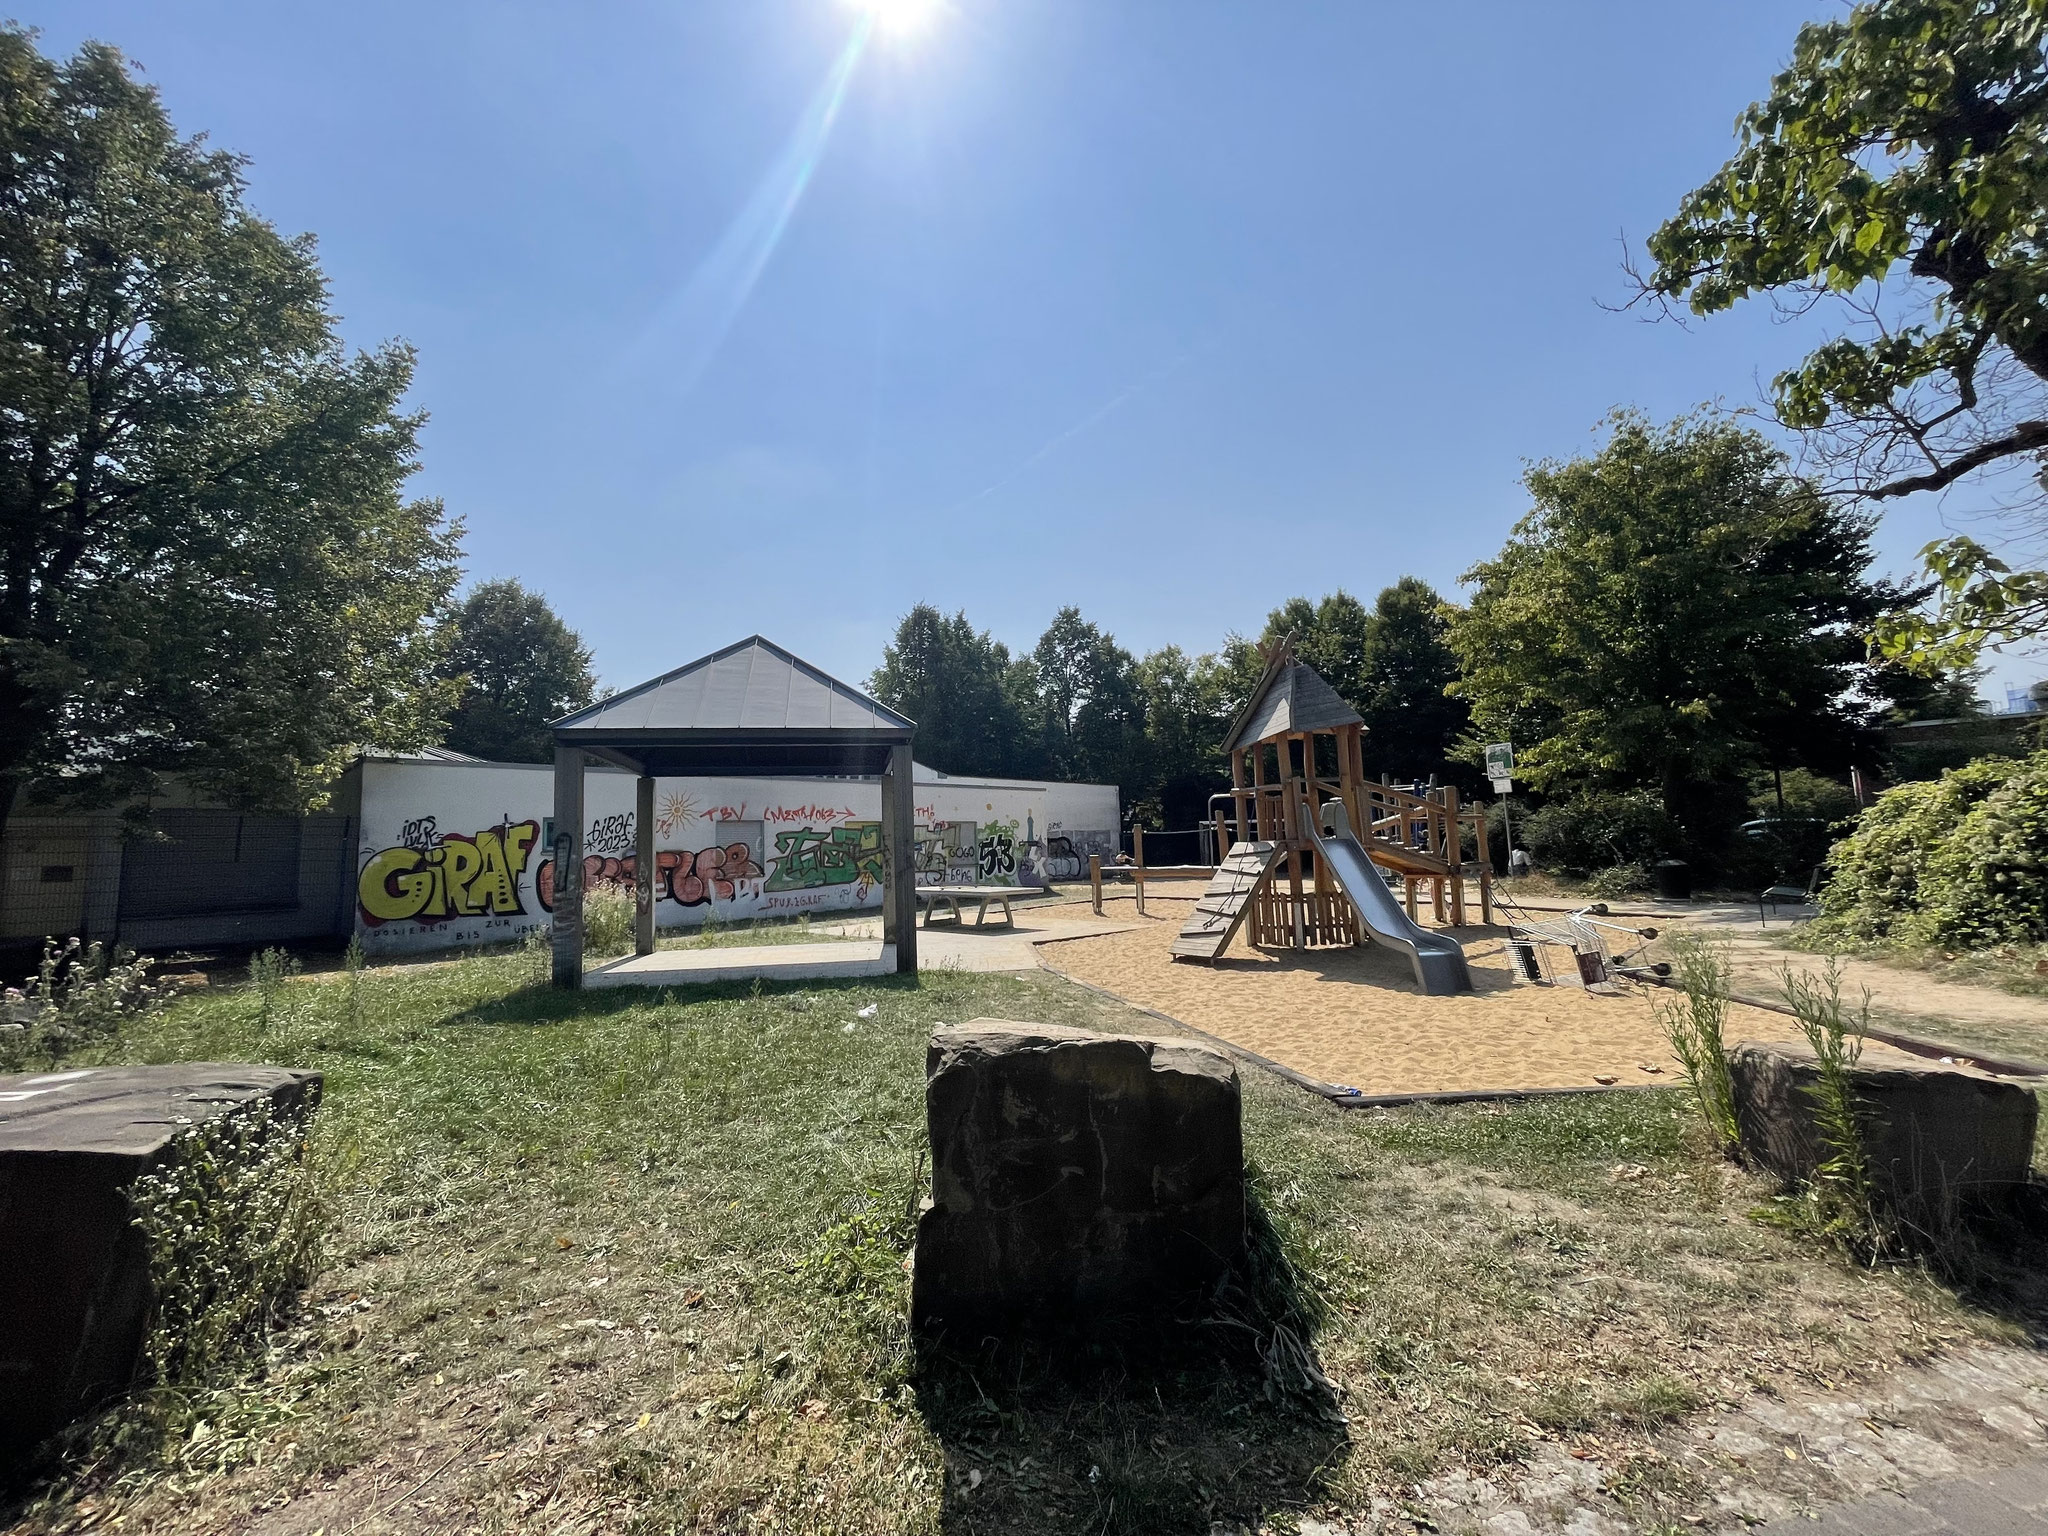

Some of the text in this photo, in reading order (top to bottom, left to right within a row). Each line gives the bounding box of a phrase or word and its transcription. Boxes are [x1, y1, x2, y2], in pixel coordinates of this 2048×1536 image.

[597, 834, 631, 853] 2023
[456, 932, 480, 941] BIS
[485, 919, 511, 929] ZUR
